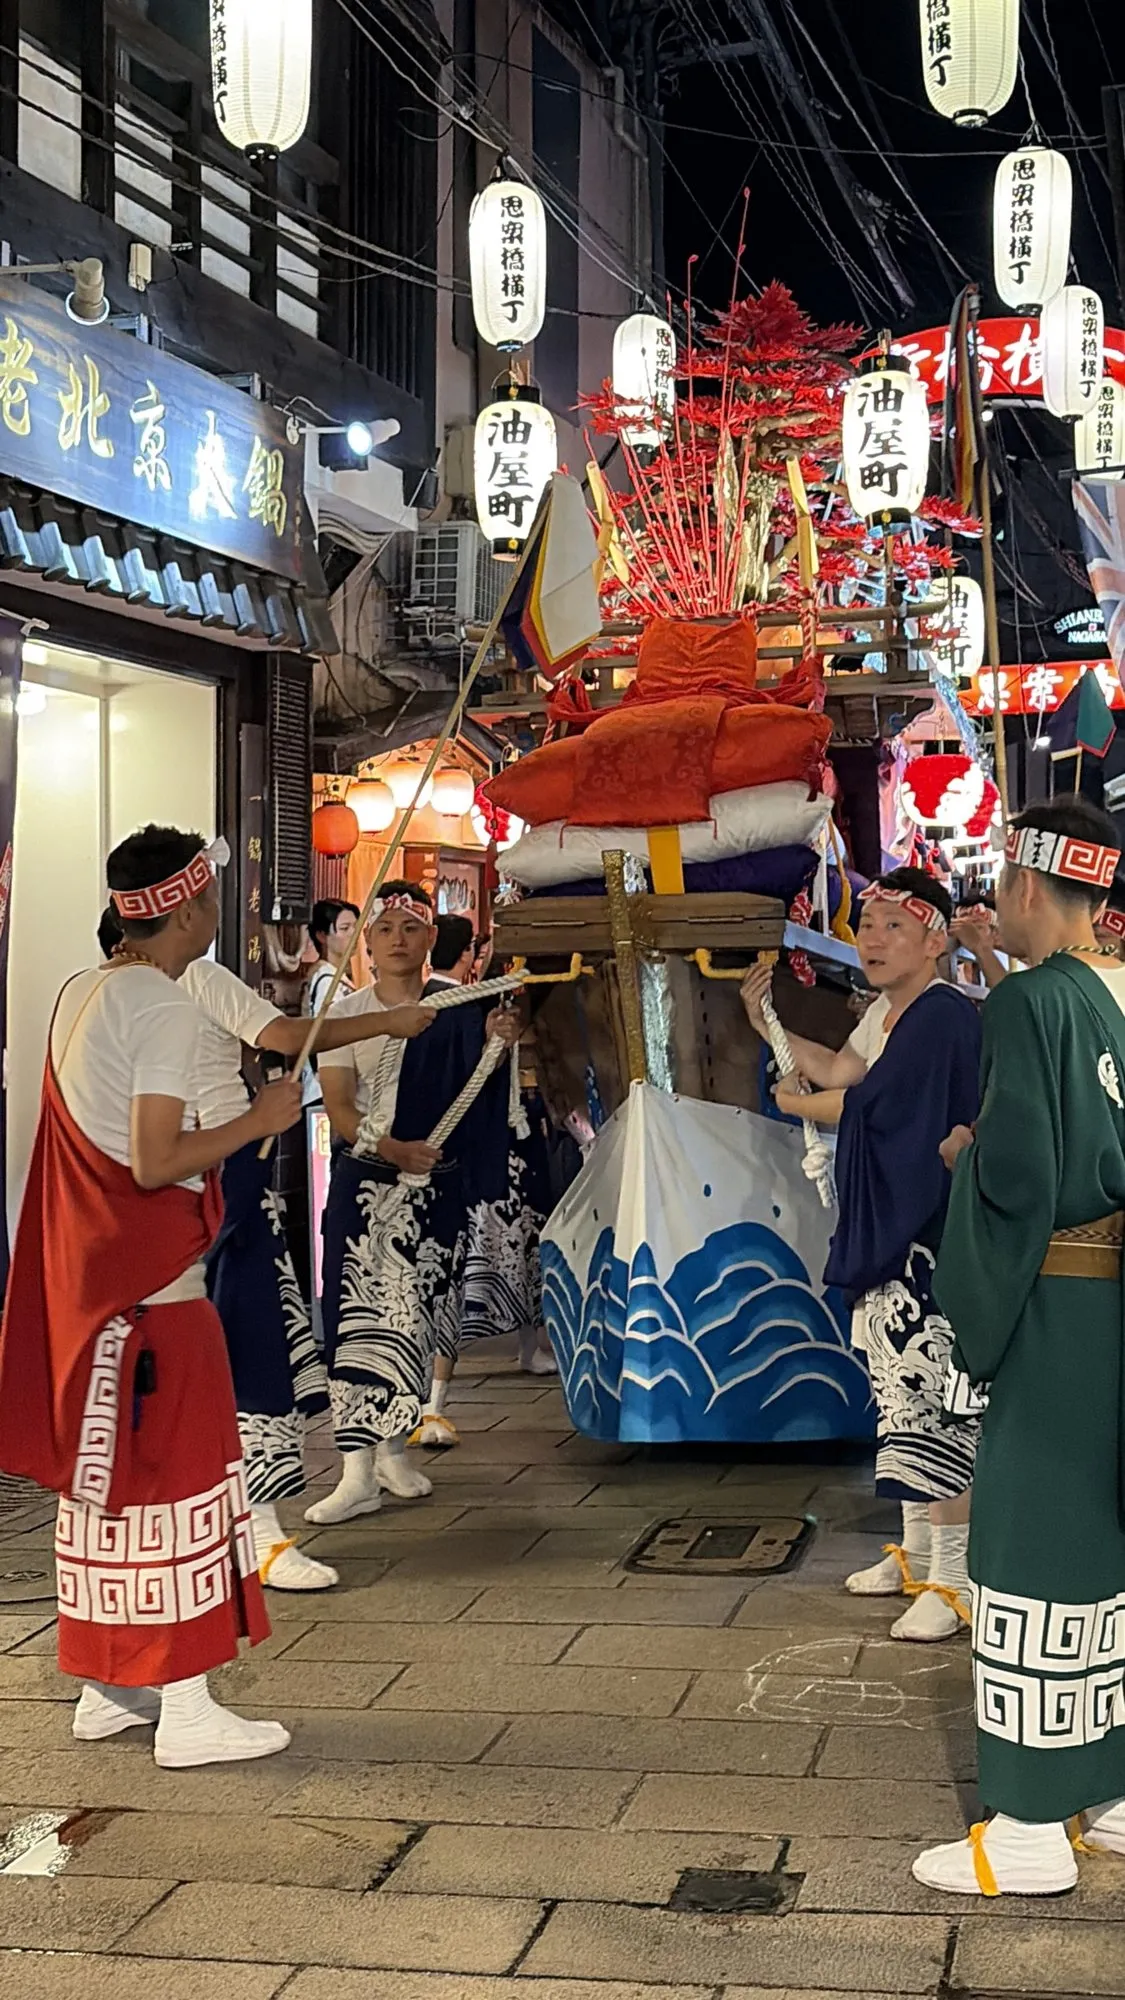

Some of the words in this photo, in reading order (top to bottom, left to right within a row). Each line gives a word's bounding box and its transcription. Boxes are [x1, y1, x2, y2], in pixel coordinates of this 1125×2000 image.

[487, 408, 535, 528] 油屋町
[858, 377, 908, 498] 油屋町
